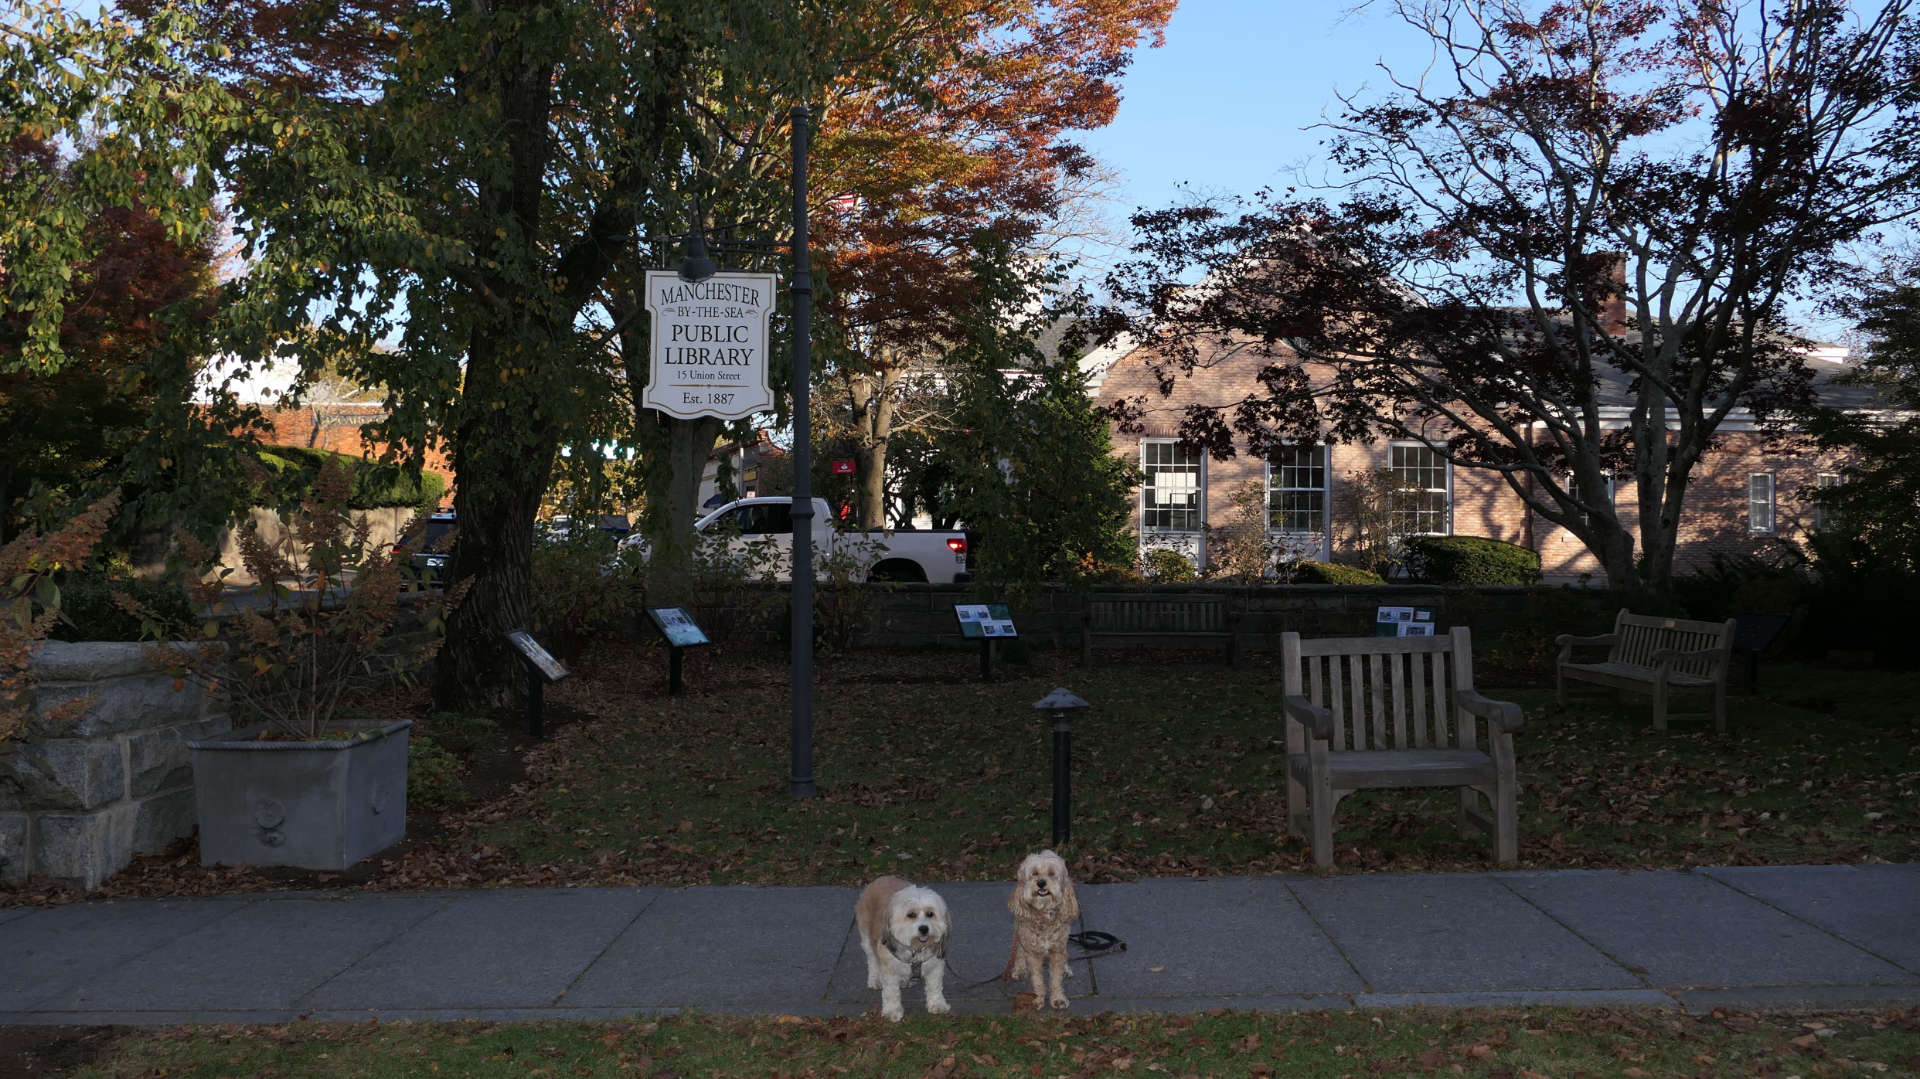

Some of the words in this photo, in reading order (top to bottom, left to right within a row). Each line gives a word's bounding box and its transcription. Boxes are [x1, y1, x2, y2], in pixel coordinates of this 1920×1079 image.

[661, 282, 760, 307] MANCHESTER
[677, 306, 744, 319] BY-THE-SEA
[671, 324, 749, 343] PUBLIC
[664, 347, 754, 366] LIBRARY
[677, 371, 687, 380] 15
[690, 370, 715, 381] Union
[717, 371, 740, 381] Street
[683, 392, 703, 404] Est.
[708, 393, 735, 405] 1887
